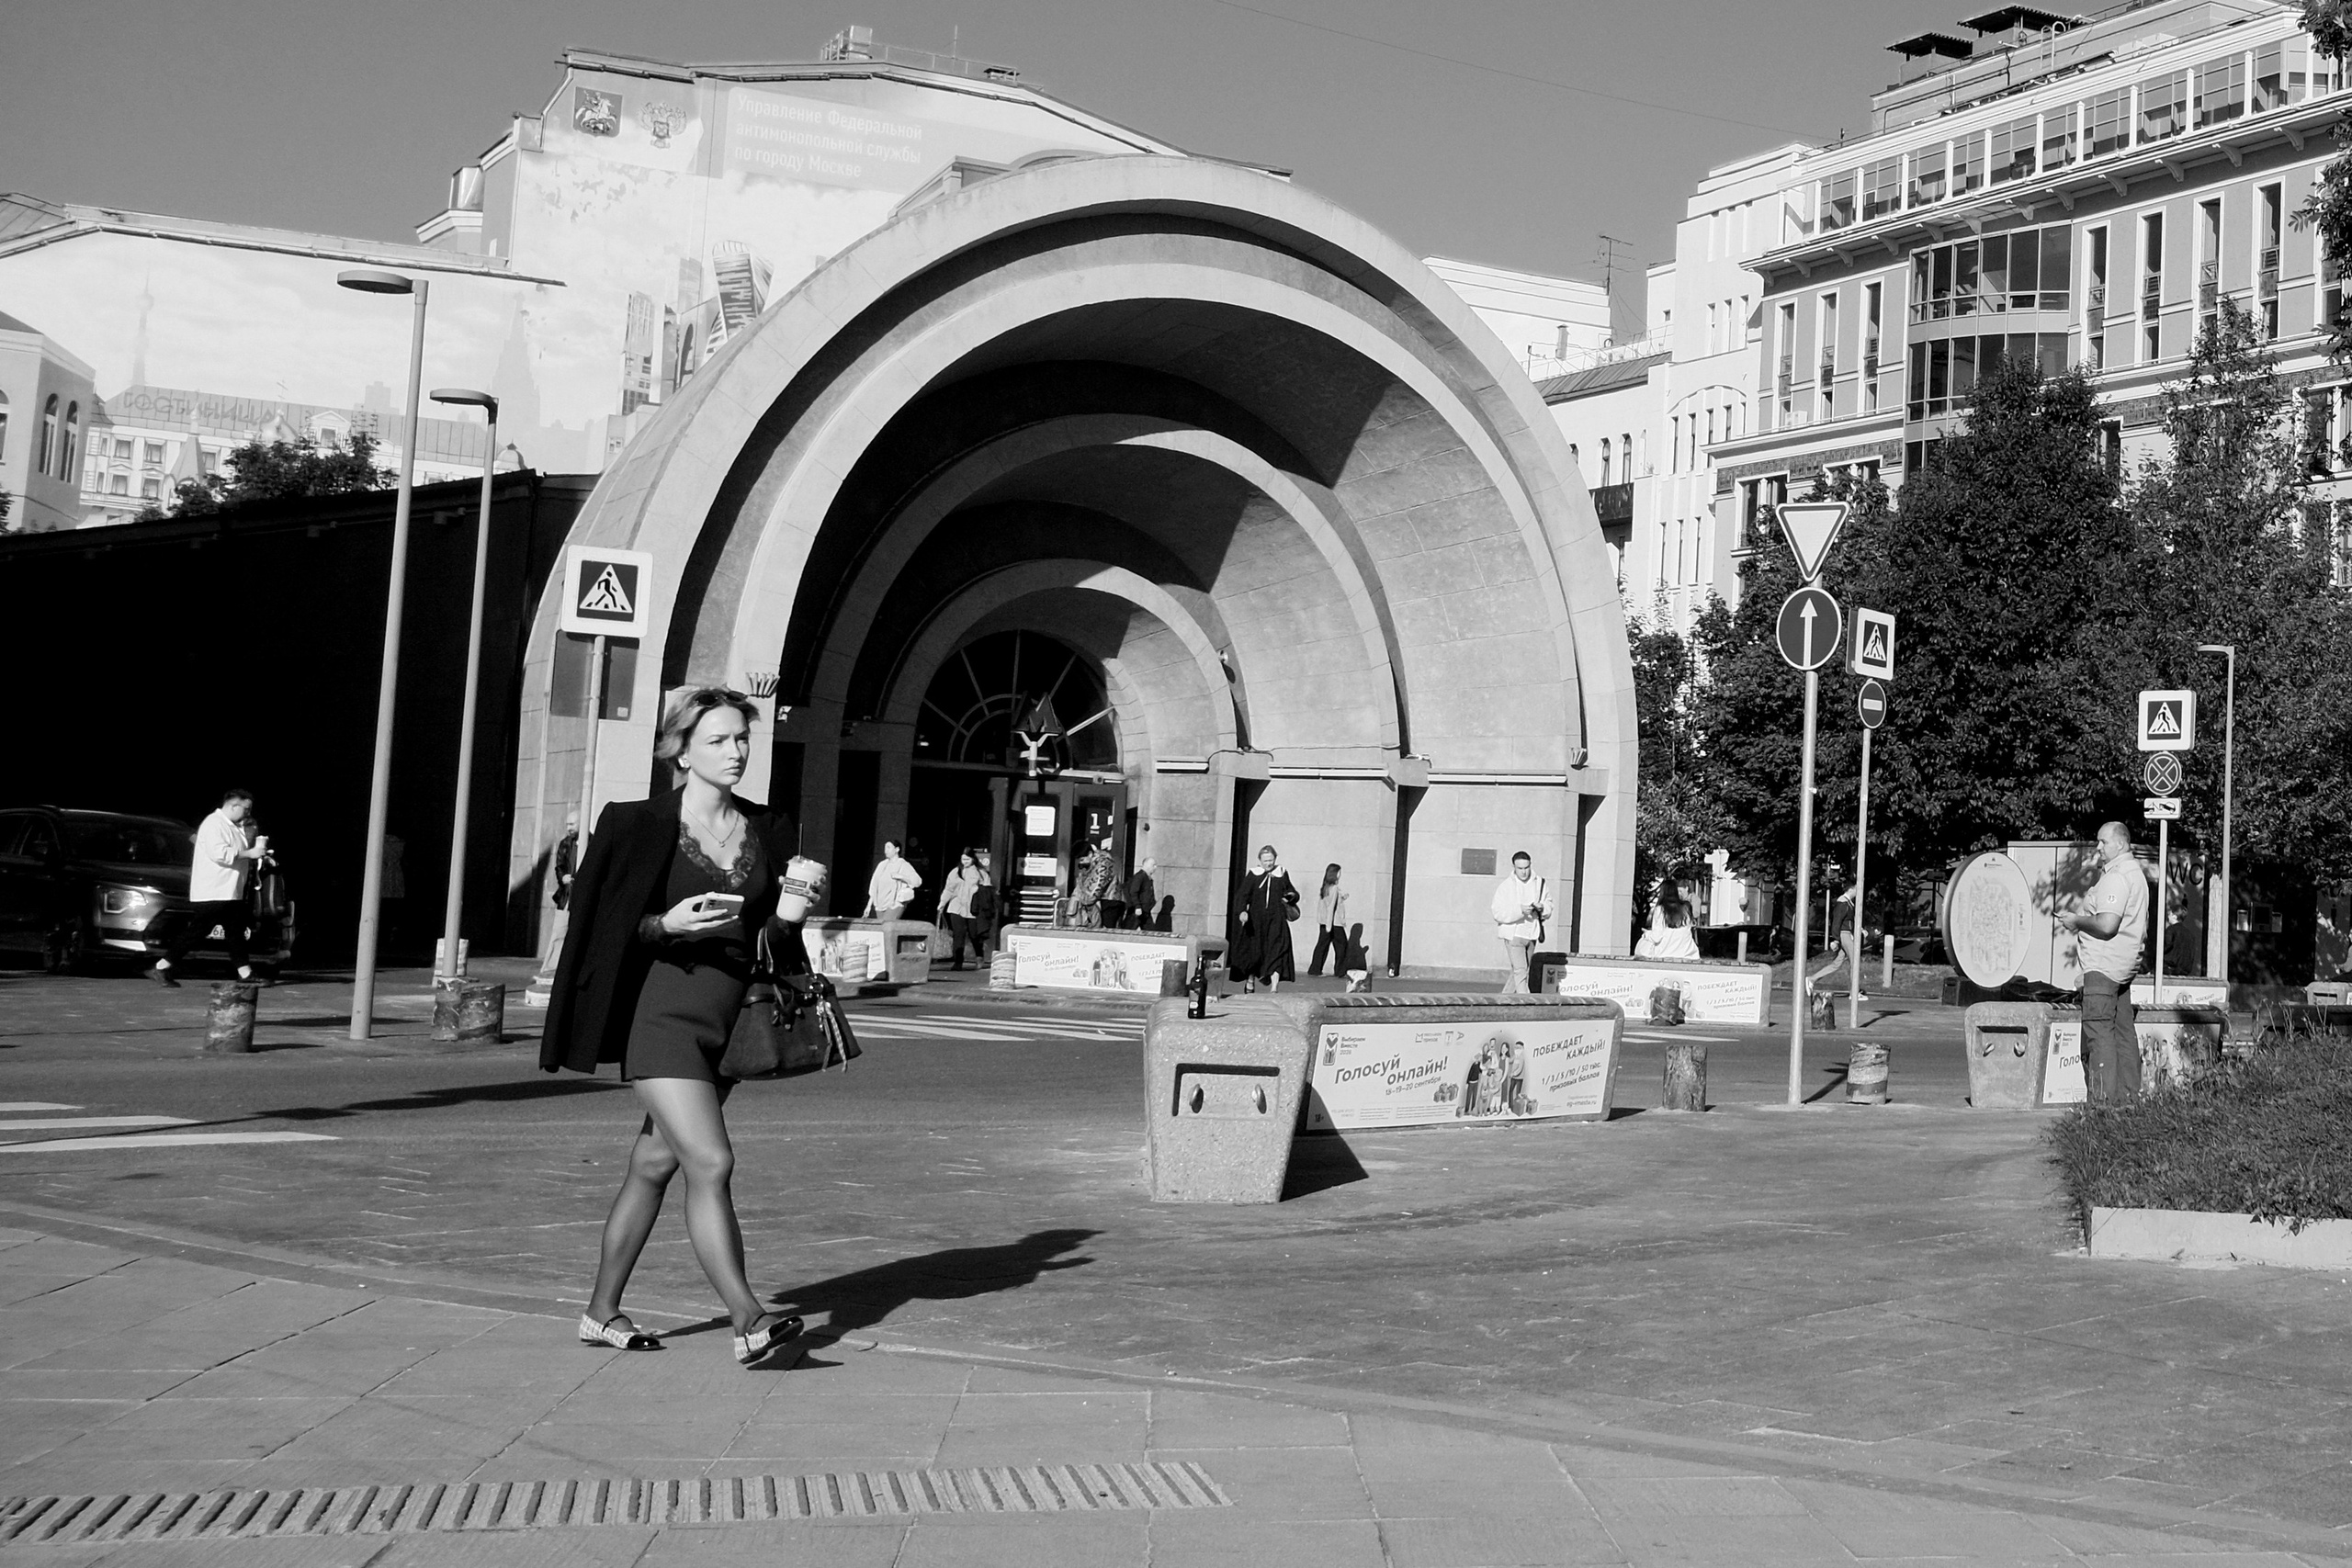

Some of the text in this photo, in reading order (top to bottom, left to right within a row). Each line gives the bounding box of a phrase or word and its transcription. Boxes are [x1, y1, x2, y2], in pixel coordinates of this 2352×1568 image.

[738, 94, 922, 141] Управление Федеральной
[736, 122, 922, 164] антимонопольной службы
[735, 145, 862, 178] по городу Москве
[2168, 861, 2203, 886] WC
[1697, 980, 1737, 991] ПОБЕЖДАЕТ
[1532, 1034, 1584, 1058] ПОБЕЖДАЕТ
[1566, 1039, 1606, 1060] КАЖДЫЙ!
[1335, 1053, 1402, 1084] Голосуй
[1387, 1055, 1448, 1085] онлайн!
